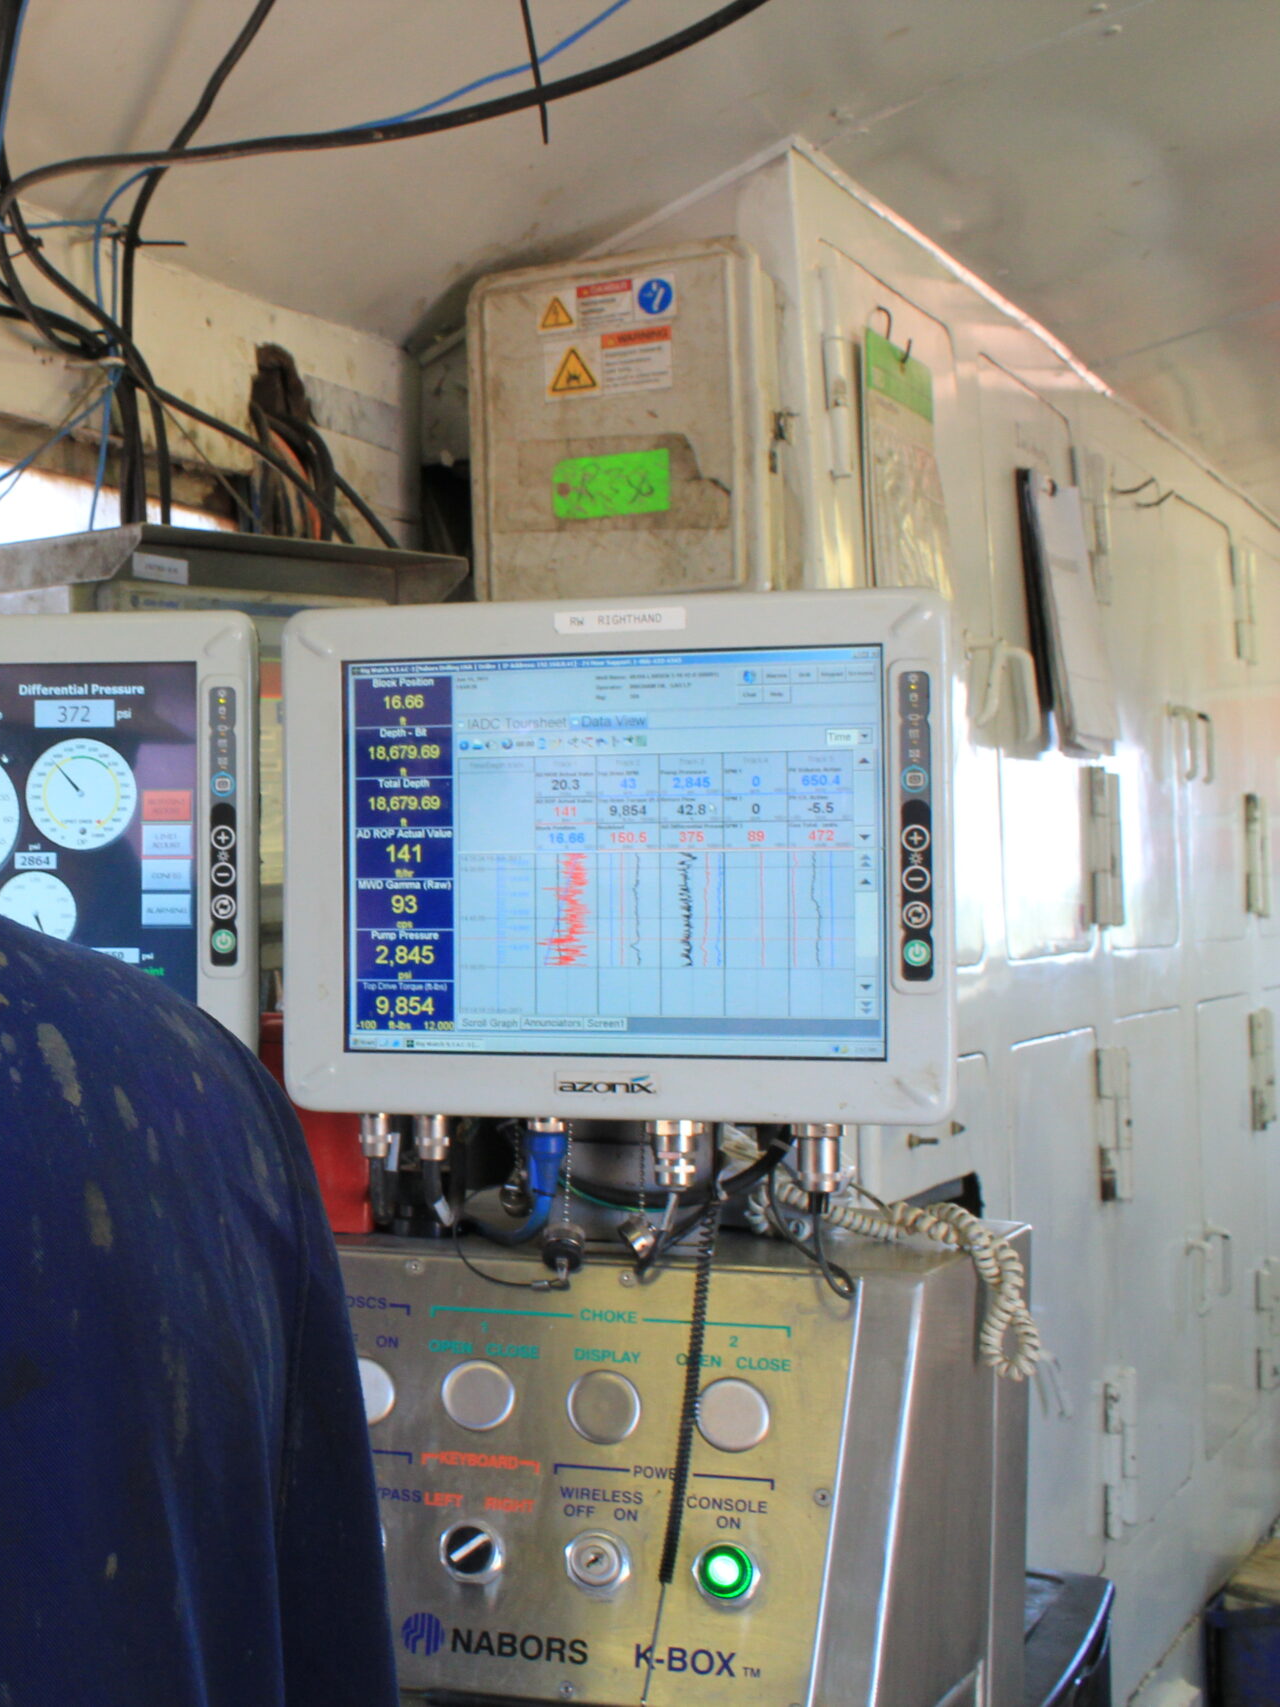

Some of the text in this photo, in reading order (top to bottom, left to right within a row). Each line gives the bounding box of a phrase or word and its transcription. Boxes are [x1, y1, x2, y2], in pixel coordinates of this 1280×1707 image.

[617, 328, 669, 344] WARNING
[570, 612, 663, 627] RW RIGHTHAND
[372, 677, 435, 688] Block Position
[19, 684, 145, 696] Differential Pressure
[384, 694, 424, 709] 16.66
[58, 705, 132, 723] 372 psi
[467, 716, 567, 730] IADC Toursheet
[581, 714, 647, 728] Data View
[380, 728, 407, 739] Depth
[415, 727, 427, 737] Bit
[828, 731, 851, 742] Time
[368, 744, 441, 762] 18,679.69
[378, 779, 430, 789] Total Depth
[552, 779, 580, 790] 20.3
[620, 778, 637, 789] 43
[673, 776, 711, 790] 2,845
[752, 775, 760, 787] 0
[802, 774, 841, 787] 650.4
[368, 795, 441, 812] 18,679.69
[677, 804, 706, 815] 42.8
[752, 803, 760, 814] 0
[808, 802, 834, 813] -5.5
[554, 806, 577, 817] 141
[609, 805, 647, 818] 9,854
[357, 829, 452, 839] AD ROP Actual Value
[549, 832, 585, 844] 16.66
[610, 832, 647, 843] 150.5
[679, 831, 704, 843] 375
[748, 830, 765, 842] 89
[808, 830, 834, 841] 472
[386, 844, 422, 863] 141
[20, 856, 51, 867] 2864
[358, 880, 452, 891] MWD Gamma (Raw)
[391, 895, 418, 914] 93
[371, 930, 439, 941] Pump Pressure
[375, 945, 435, 967] 2,845
[376, 995, 435, 1018] 9,854
[461, 1018, 518, 1029] Scroll Graph
[524, 1018, 581, 1028] Annunciators
[587, 1018, 624, 1028] Screen1
[559, 1076, 654, 1094] azonix
[580, 1308, 638, 1324] CHOKE
[376, 1335, 399, 1348] ON
[729, 1336, 738, 1348] 2
[428, 1339, 540, 1359] OPEN CLOSE
[574, 1347, 640, 1364] DISPLAY
[676, 1353, 791, 1372] OEN CLOSE
[438, 1451, 519, 1470] KEYBOARD
[633, 1465, 680, 1481] POWE
[423, 1491, 536, 1512] LEFT RIGHT
[560, 1486, 643, 1505] WIRELESS
[686, 1496, 768, 1514] CONSOLE
[564, 1504, 638, 1522] OFF ON
[716, 1516, 741, 1530] ON
[451, 1628, 589, 1666] NABORS
[634, 1643, 761, 1678] K-BOX TM
